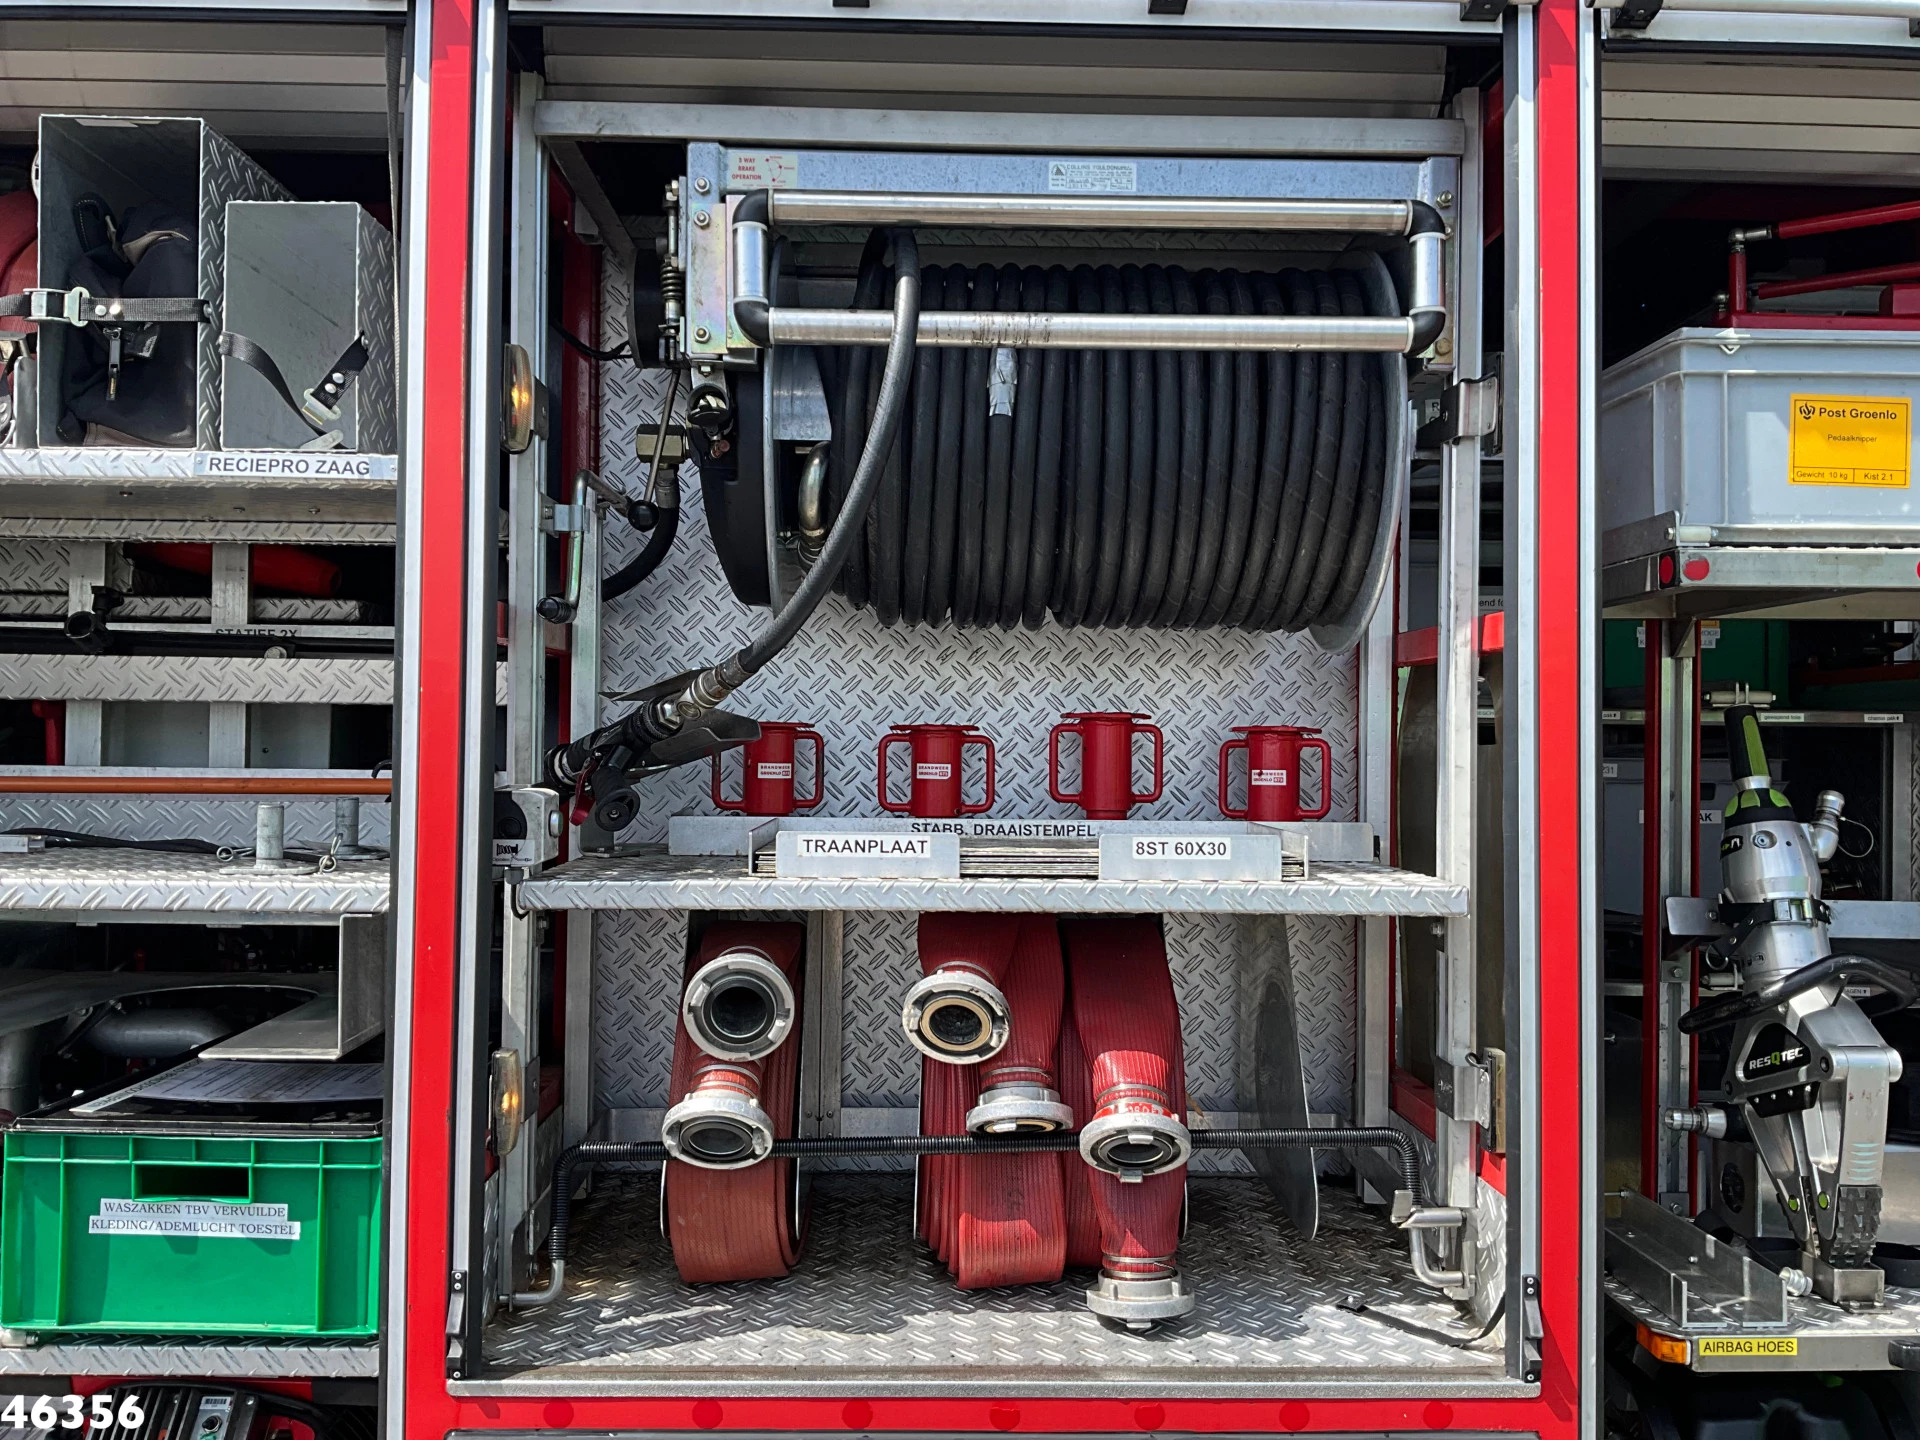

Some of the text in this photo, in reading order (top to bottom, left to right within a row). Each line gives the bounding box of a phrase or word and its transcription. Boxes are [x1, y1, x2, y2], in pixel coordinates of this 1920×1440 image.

[1819, 407, 1897, 420] Post Groenlo
[1827, 433, 1878, 444] Pedaalknipper
[209, 457, 370, 475] RECIEPRO ZAAG
[1796, 470, 1848, 480] Gewicht 10 kg
[1863, 472, 1880, 481] Kist
[910, 822, 1096, 837] STABB. DRAAISTEMPEL
[802, 839, 928, 854] TRAANPLAAT
[1135, 841, 1228, 856] 8ST 60X30
[1749, 1046, 1804, 1070] RESQTEC
[103, 1202, 286, 1217] WASZAKKEN TBV VERVUILDE
[91, 1219, 296, 1235] KLEDING/ADEMLUCHT TOESTEL
[1703, 1341, 1795, 1353] AIRBAG HOES
